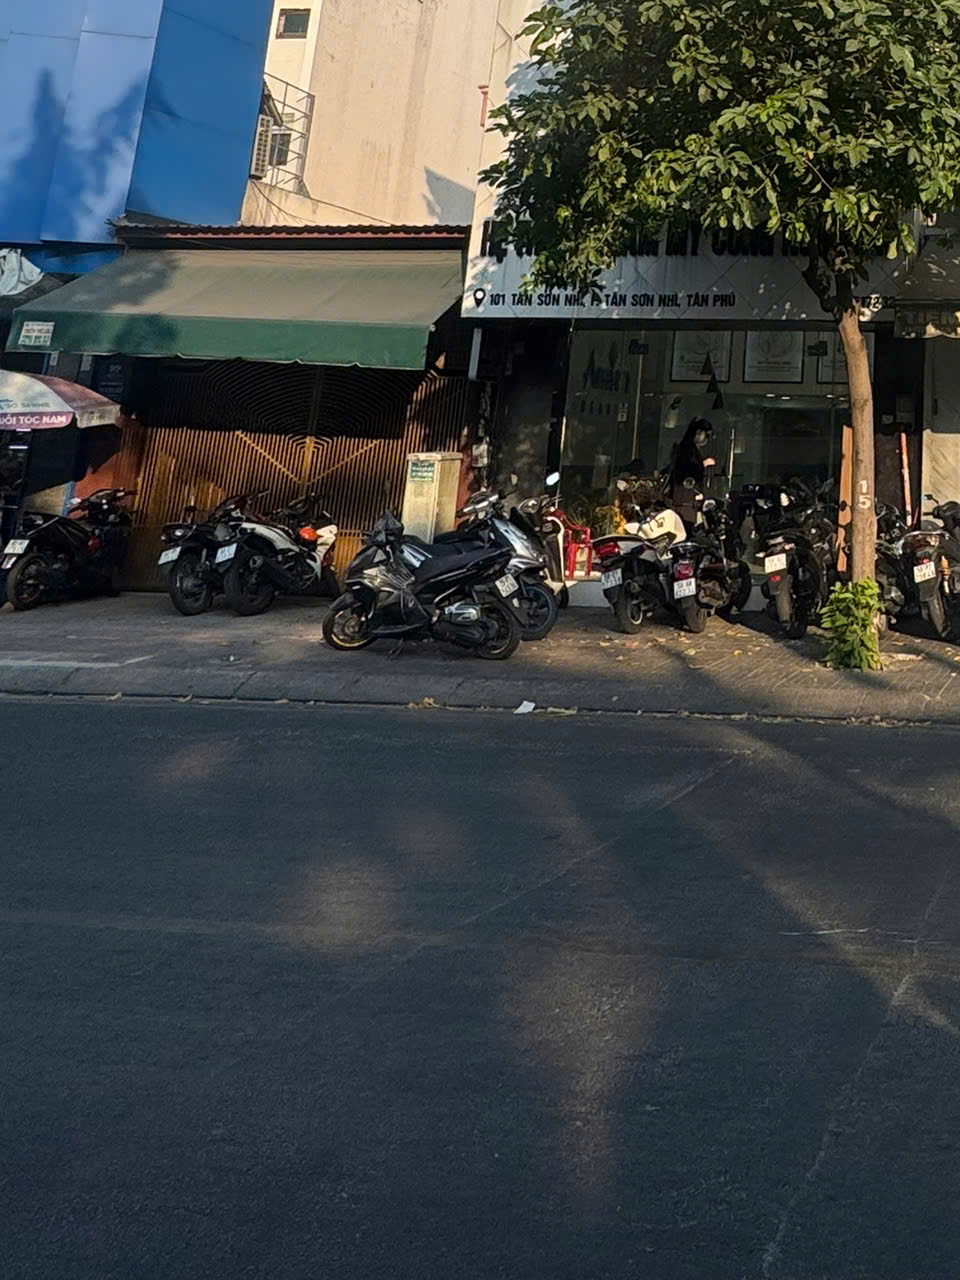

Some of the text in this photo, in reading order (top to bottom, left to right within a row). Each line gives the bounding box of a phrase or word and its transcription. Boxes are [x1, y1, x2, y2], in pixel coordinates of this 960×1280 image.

[490, 294, 505, 306] 101
[606, 291, 627, 306] TÂN
[631, 292, 653, 306] SƠN
[687, 291, 709, 306] TÂN
[713, 290, 736, 306] PHÚ
[18, 413, 40, 424] TÓC
[42, 415, 67, 424] NAM
